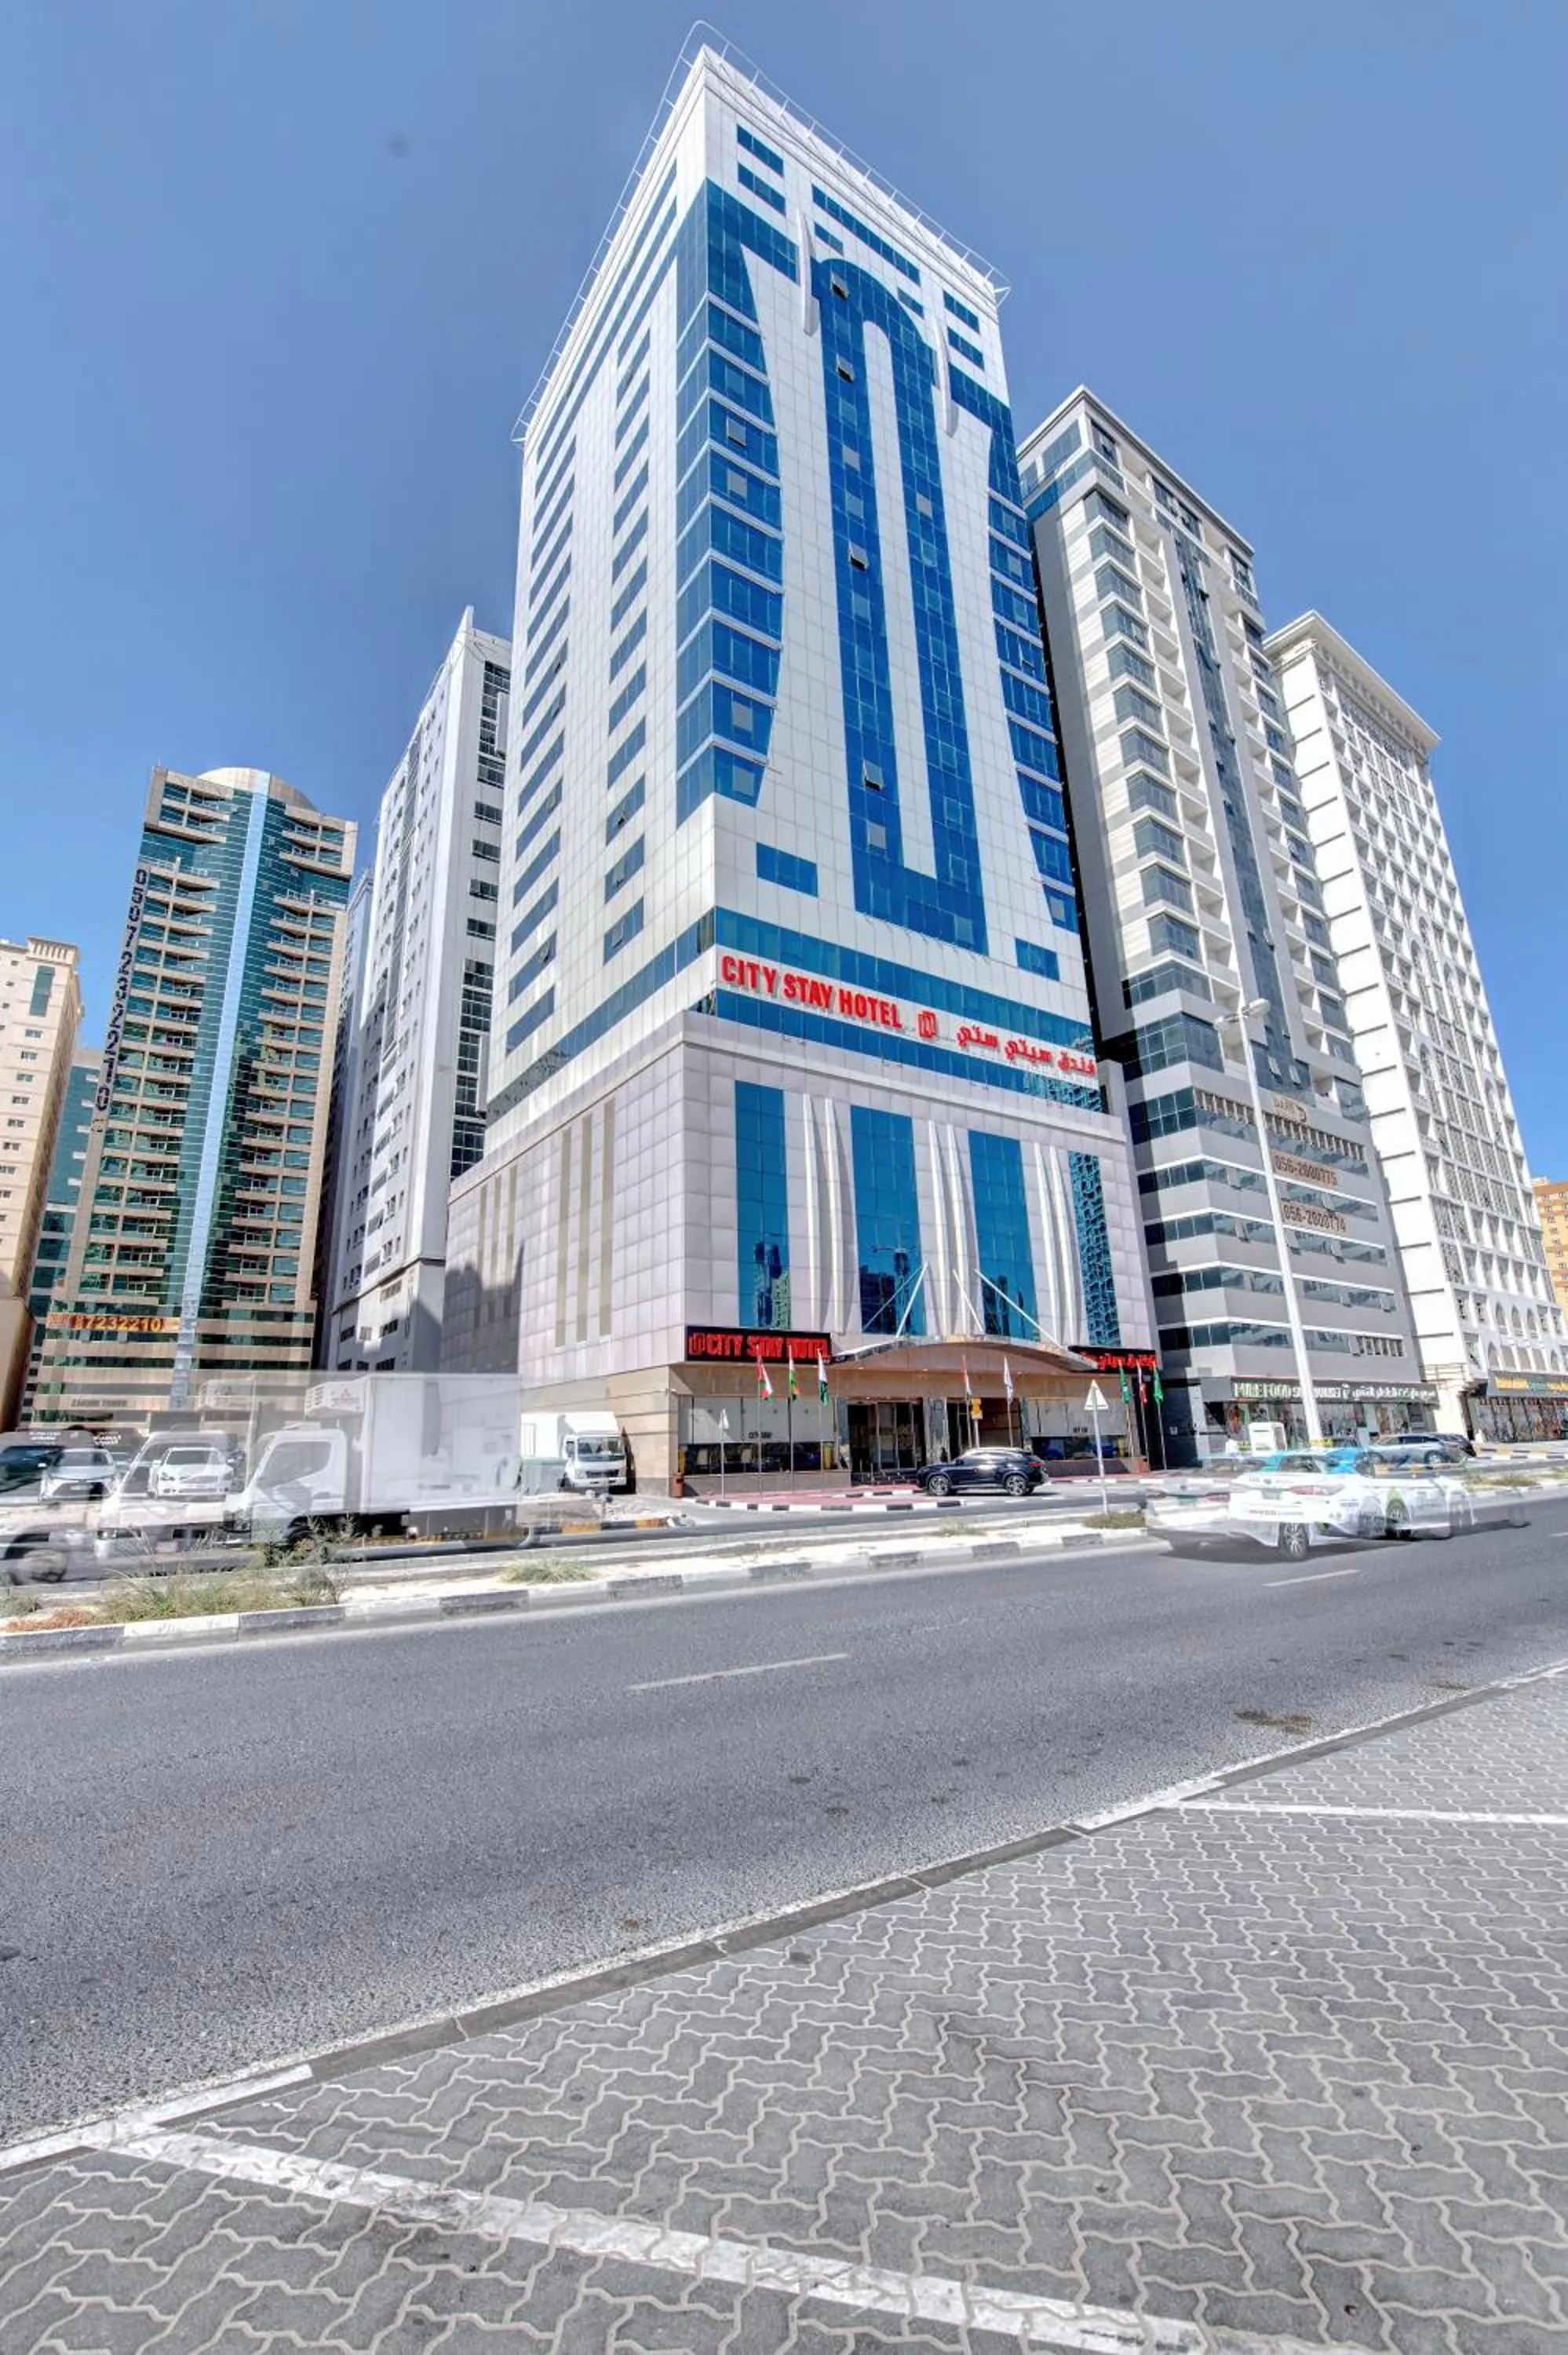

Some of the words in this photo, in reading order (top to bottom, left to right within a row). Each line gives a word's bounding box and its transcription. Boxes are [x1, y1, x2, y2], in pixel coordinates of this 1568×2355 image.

[721, 955, 777, 993] CITY
[783, 973, 833, 1009] STAY
[839, 988, 902, 1028] HOTEL
[1004, 1038, 1052, 1061] سيتي
[1058, 1050, 1096, 1075] فندق
[707, 1334, 743, 1356] CITY
[746, 1335, 784, 1358] STAY
